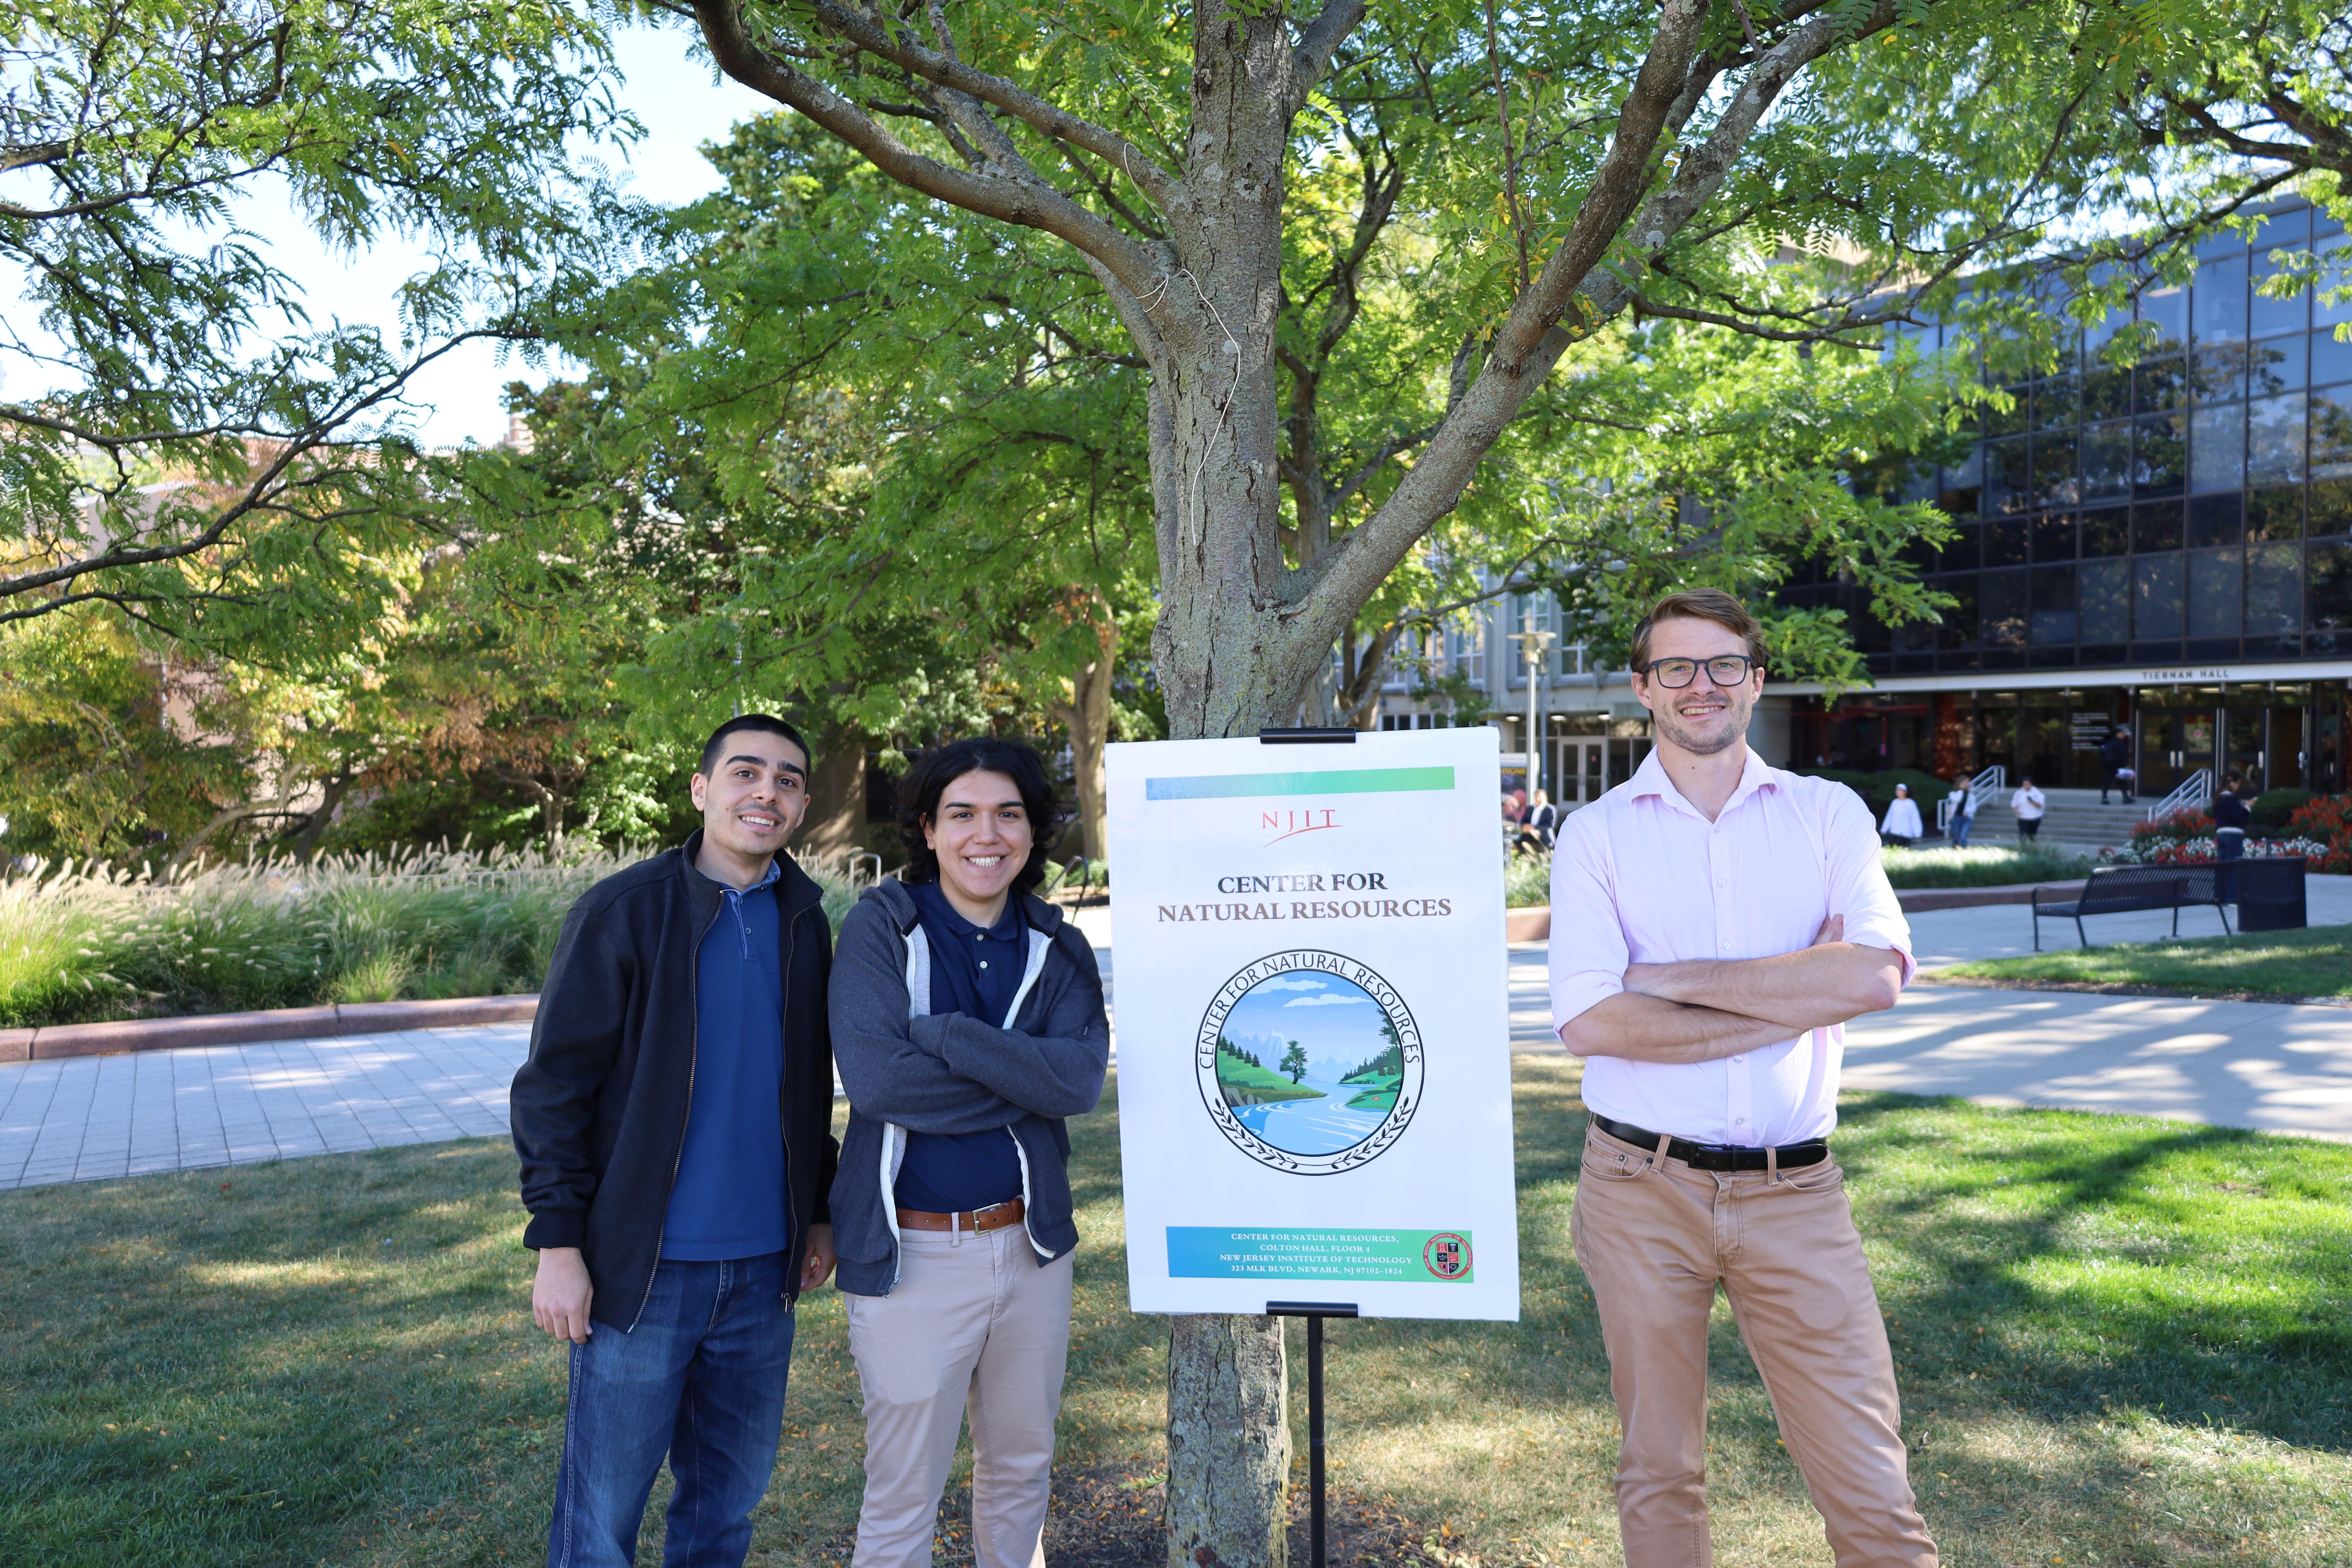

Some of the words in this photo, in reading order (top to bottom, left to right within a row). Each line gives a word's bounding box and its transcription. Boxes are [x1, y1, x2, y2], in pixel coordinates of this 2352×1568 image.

[2142, 671, 2192, 680] TIERNAN
[2200, 669, 2229, 678] HALL
[1262, 809, 1335, 833] NJIT
[1217, 874, 1326, 894] CENTER
[1331, 873, 1389, 891] FOR
[1158, 903, 1286, 922] NATURAL
[1290, 898, 1452, 919] RESOURCES
[1199, 999, 1231, 1069] CENTER
[1226, 968, 1261, 999] FOR
[1262, 953, 1348, 975] NATURAL
[1353, 968, 1420, 1064] RESOURCES
[1340, 1234, 1399, 1243] RESOURCES,
[1430, 1233, 1452, 1243] INSTITUTE
[1462, 1240, 1472, 1268] TECHNOLOGY
